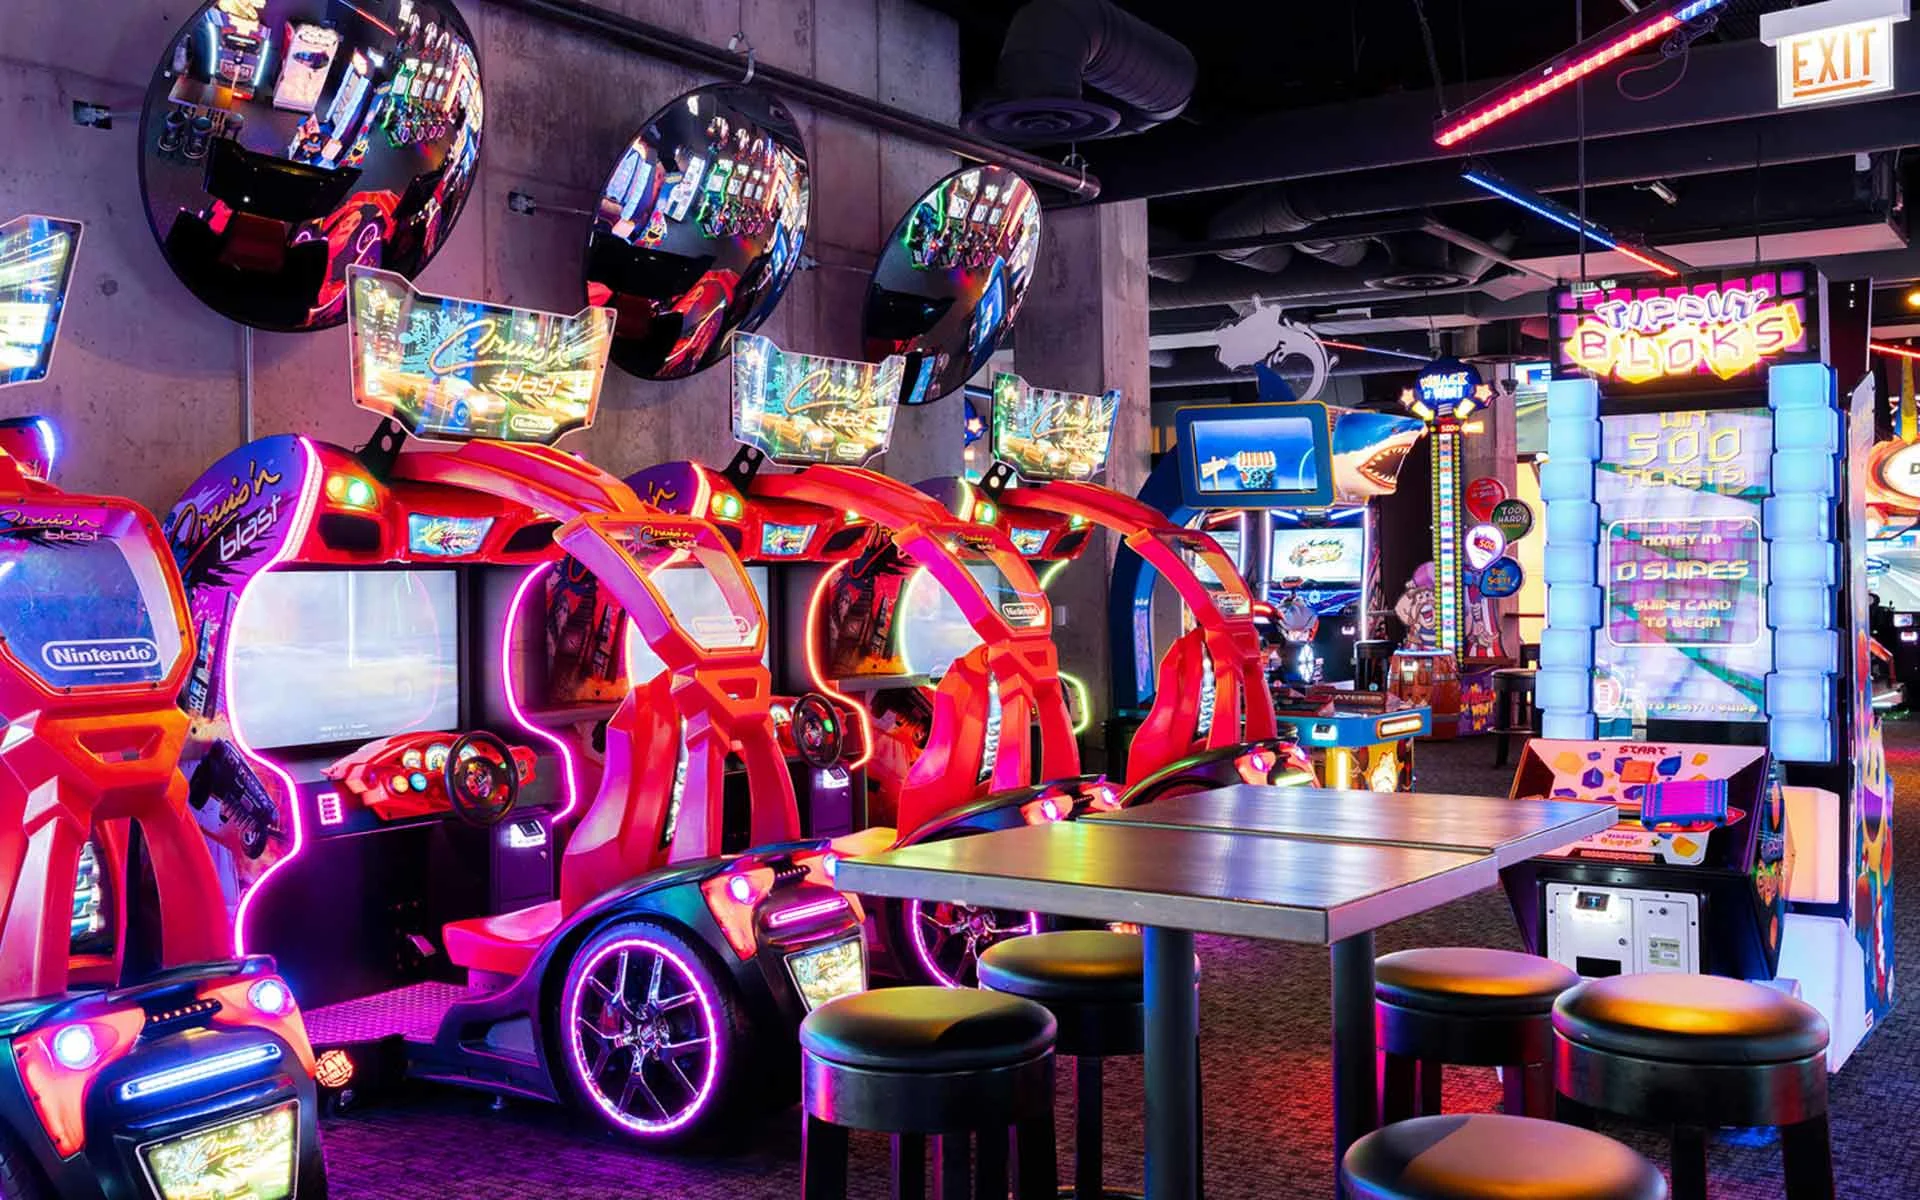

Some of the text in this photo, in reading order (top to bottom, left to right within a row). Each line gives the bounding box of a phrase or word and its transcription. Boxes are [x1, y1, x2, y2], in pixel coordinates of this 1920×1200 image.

[1792, 26, 1877, 88] EXIT
[1595, 290, 1768, 330] TIPPIN'
[1580, 316, 1784, 372] BLOKS
[497, 369, 563, 396] blast
[1627, 427, 1742, 466] 500
[45, 530, 100, 541] blast
[220, 494, 281, 561] blast
[1642, 534, 1697, 546] MONEY
[1642, 560, 1750, 580] SWIPES
[1632, 600, 1681, 611] SWIPE
[1644, 616, 1722, 629] TO BEGIN
[53, 646, 152, 665] Nintendo
[1619, 745, 1667, 755] START
